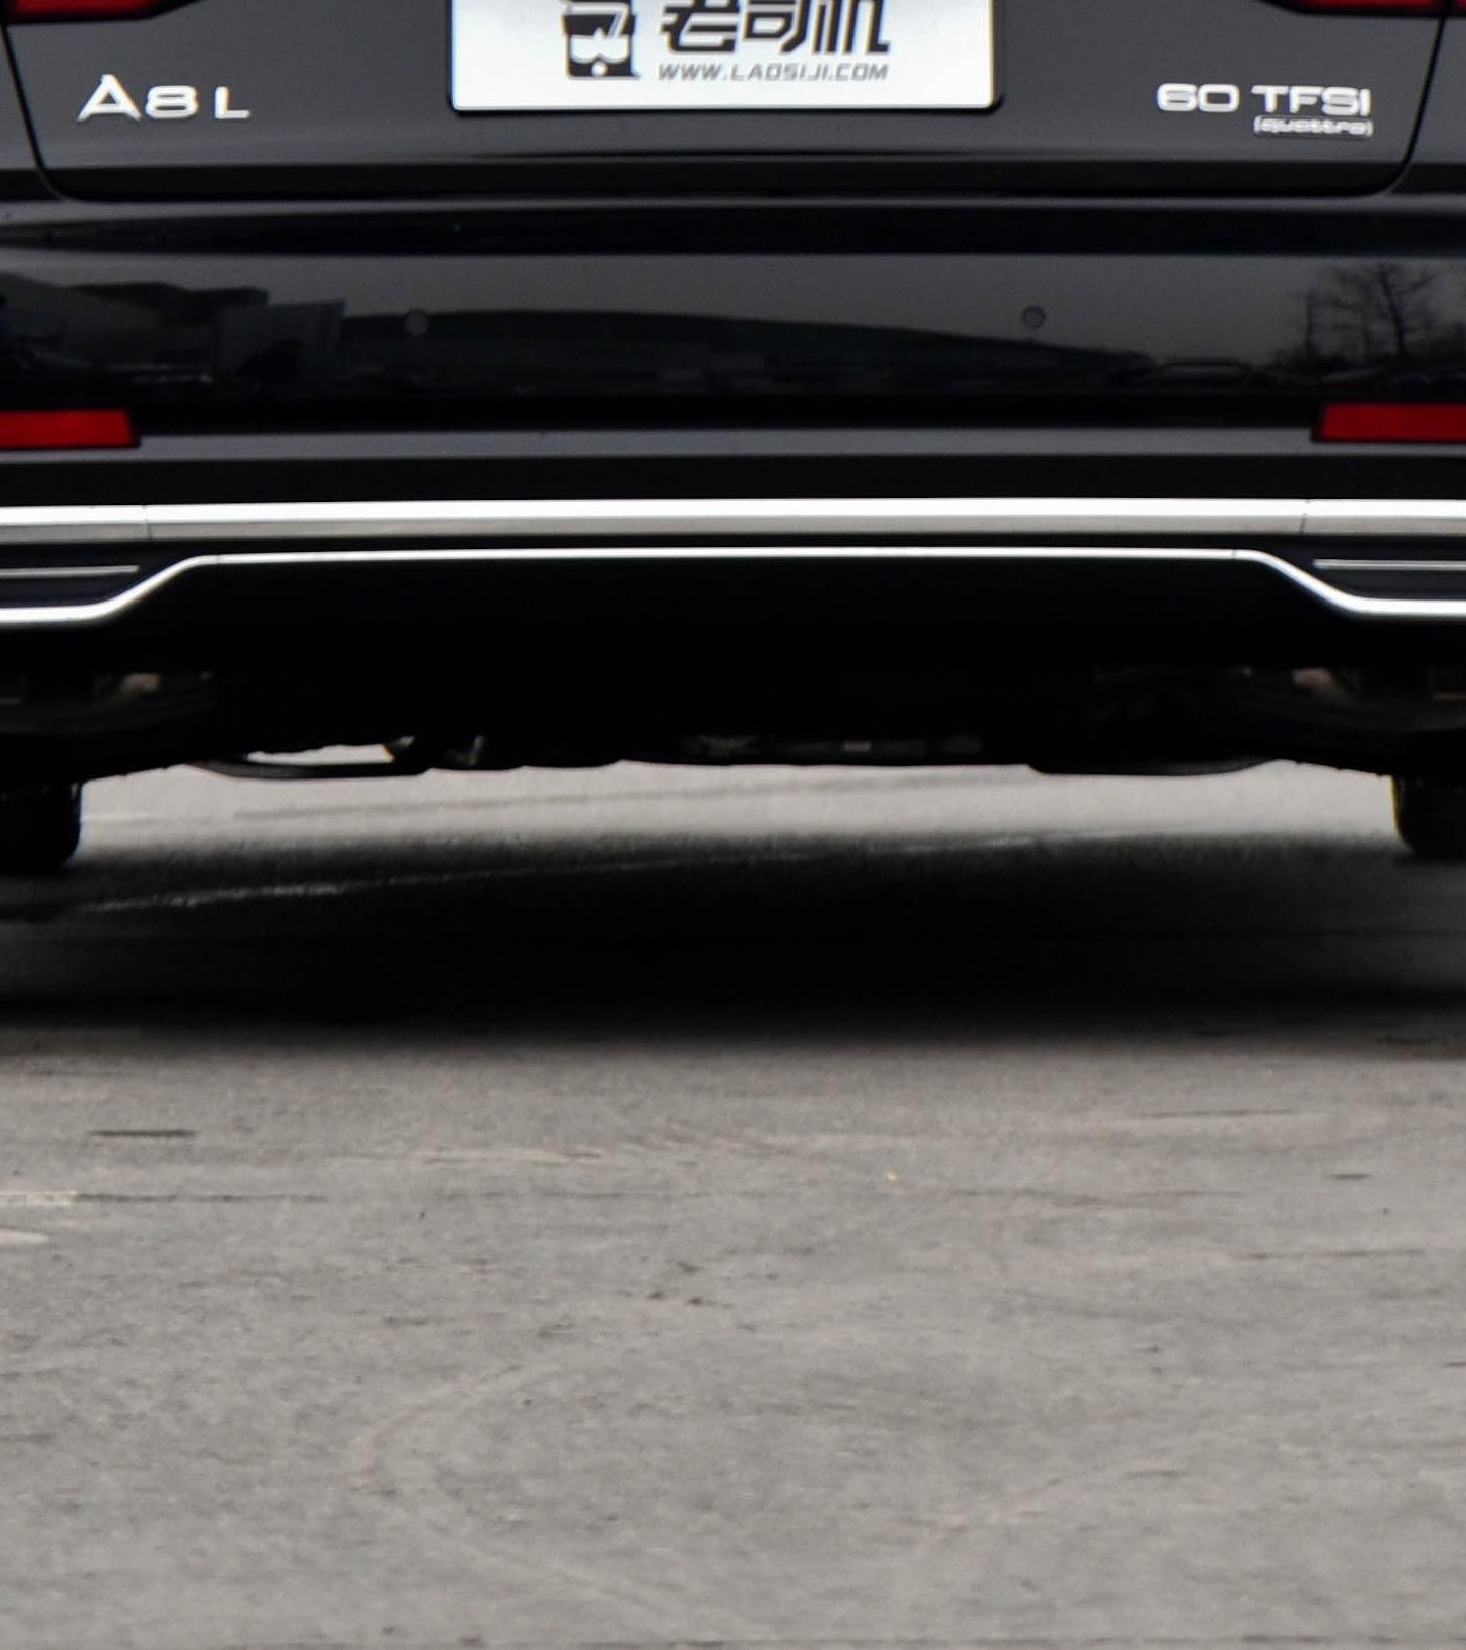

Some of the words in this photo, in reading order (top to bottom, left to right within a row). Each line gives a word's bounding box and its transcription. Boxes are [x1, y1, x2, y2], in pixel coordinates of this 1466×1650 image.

[658, 62, 889, 81] WWW.LAOSIJI.COM
[77, 73, 198, 121] A8
[214, 85, 250, 119] L
[1157, 83, 1240, 112] 60
[1251, 86, 1371, 116] TFSI
